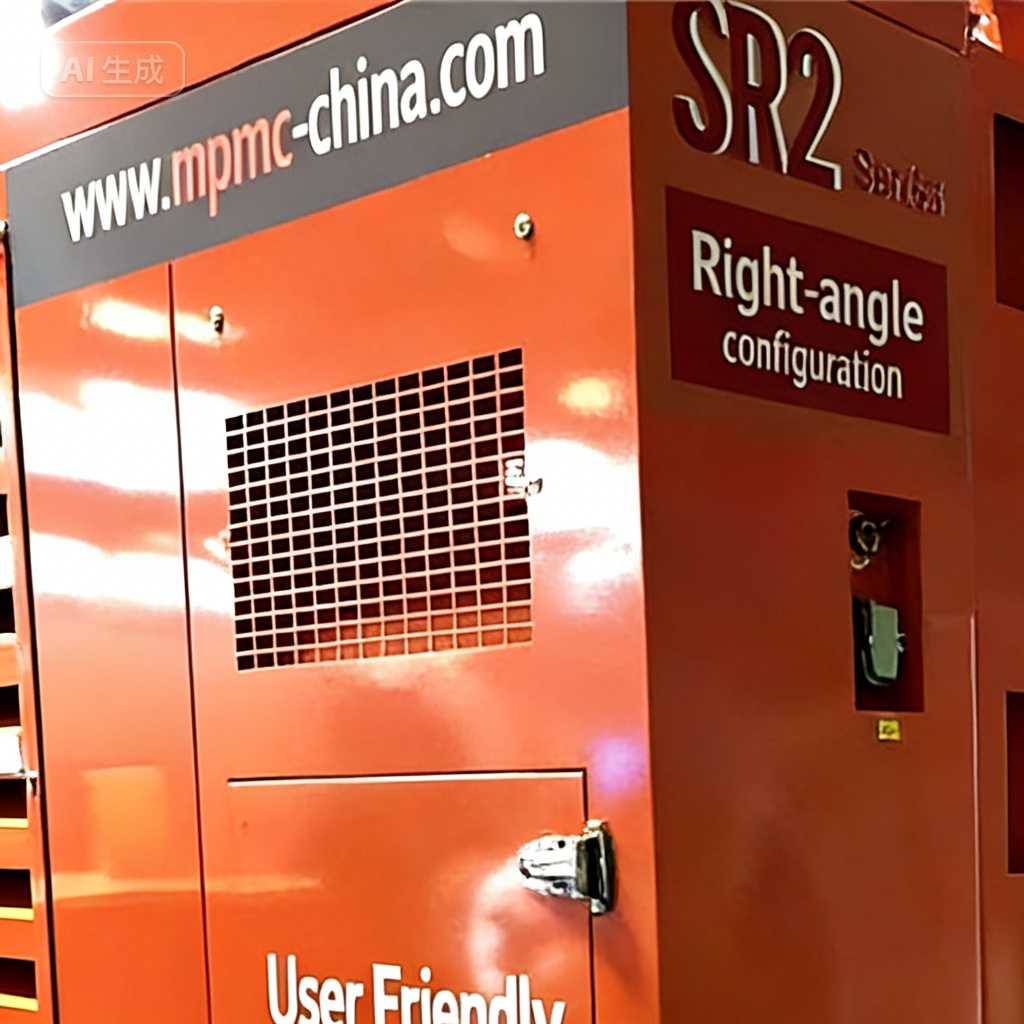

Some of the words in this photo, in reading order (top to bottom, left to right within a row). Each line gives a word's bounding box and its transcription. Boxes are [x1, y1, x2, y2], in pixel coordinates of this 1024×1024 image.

[61, 12, 545, 243] www.mpmc-china.com
[672, 0, 842, 191] SR2
[691, 229, 924, 347] Right-angle
[722, 329, 903, 399] configuration
